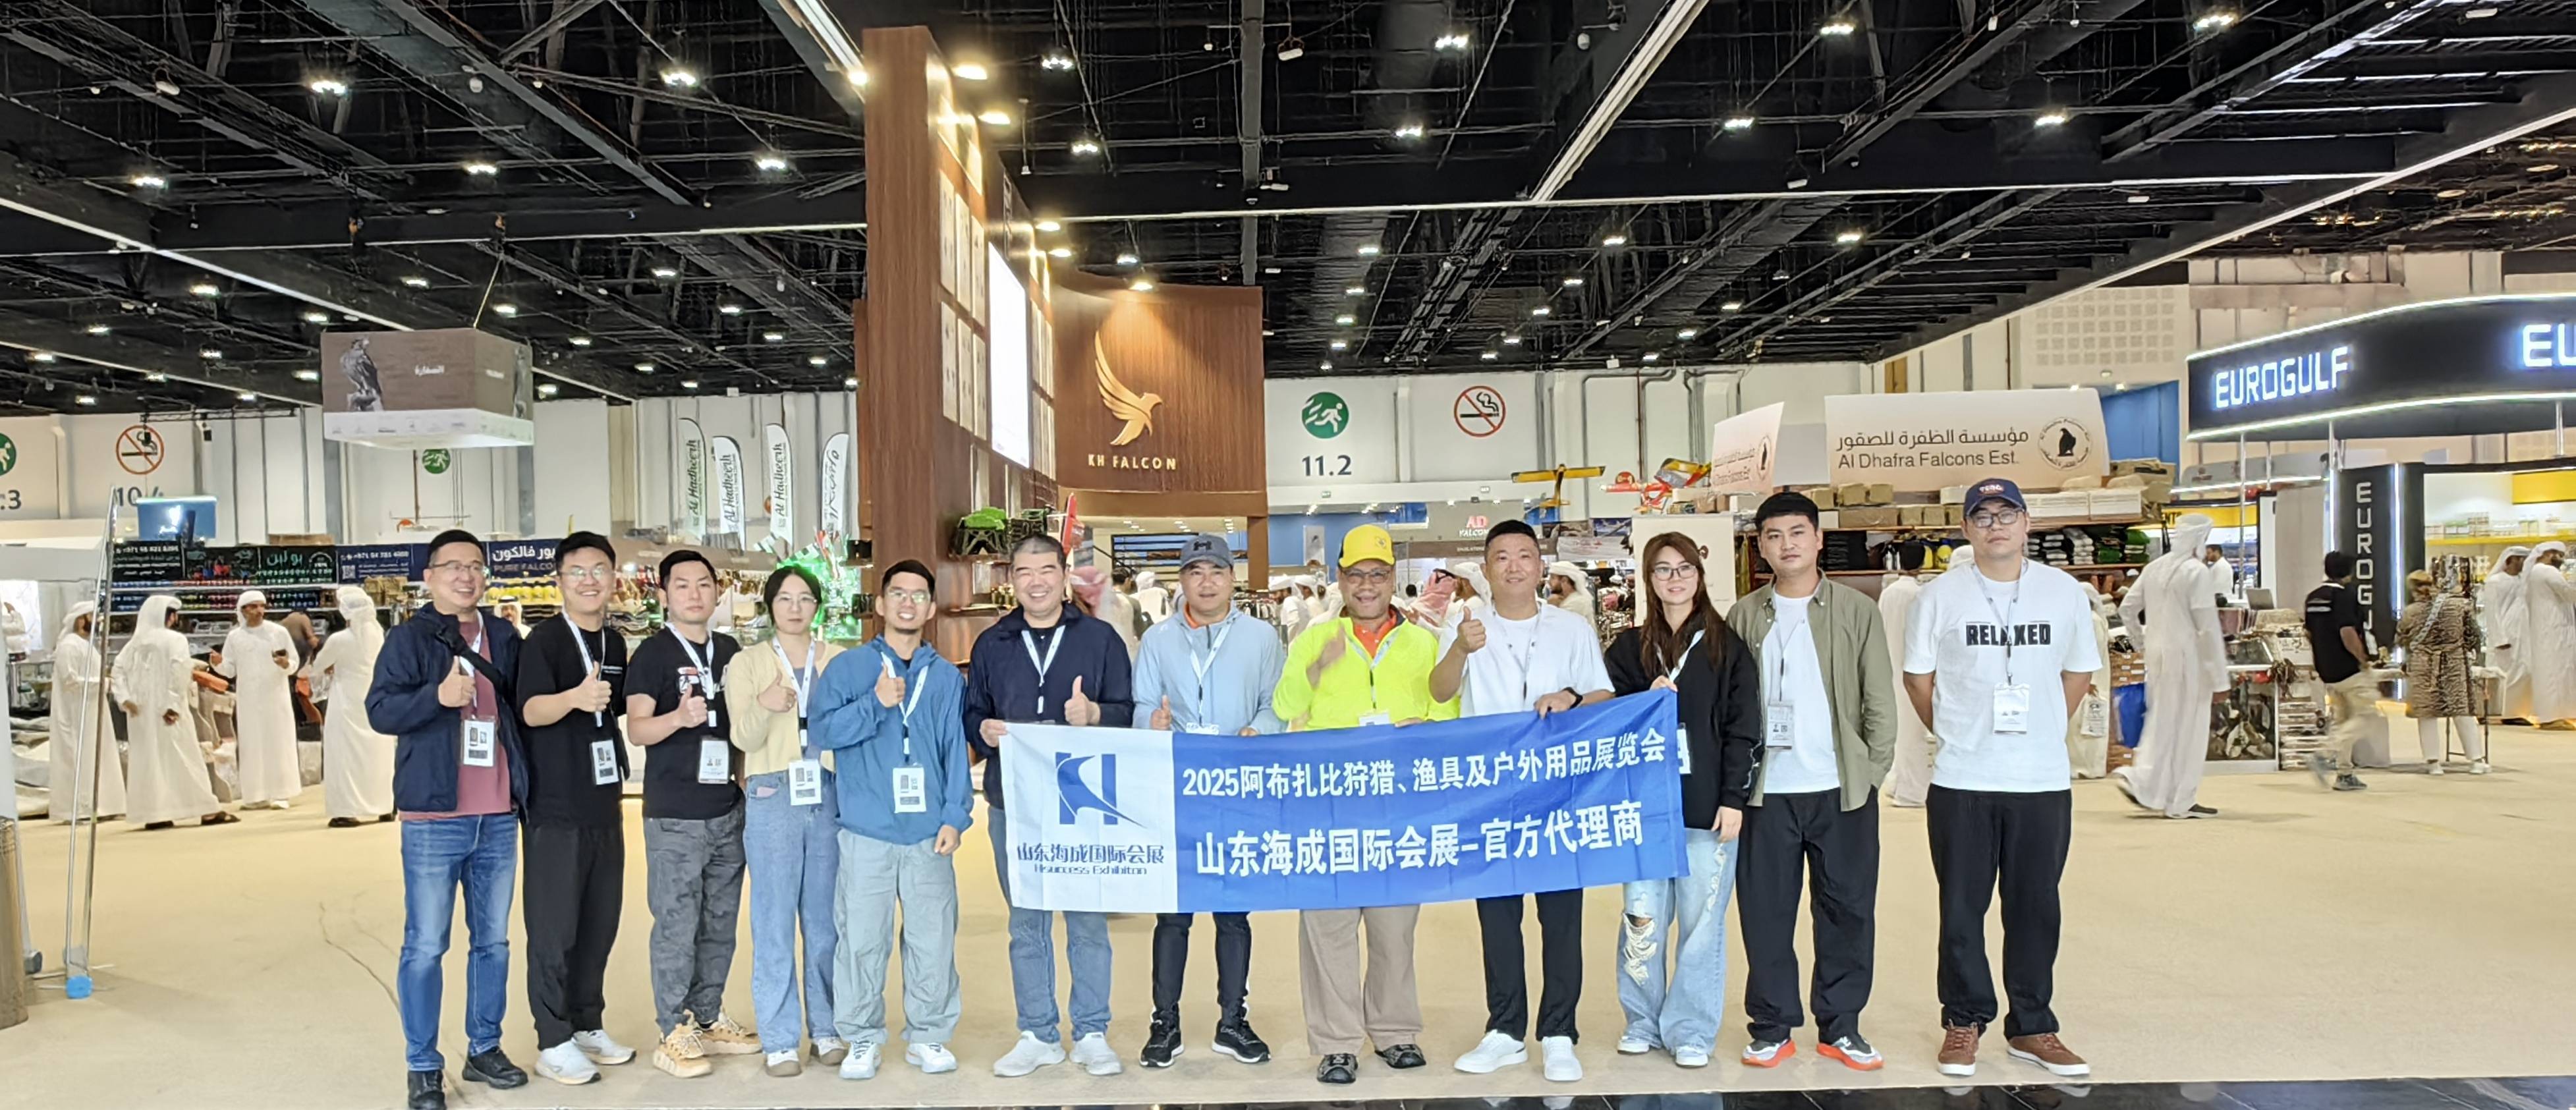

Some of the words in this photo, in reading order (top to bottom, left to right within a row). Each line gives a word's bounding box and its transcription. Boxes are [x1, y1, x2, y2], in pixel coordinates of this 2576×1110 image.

[2215, 346, 2348, 408] EUROGULF
[1835, 431, 1894, 452] للصقور
[1899, 428, 1955, 449] الظفرة
[1959, 426, 2029, 447] مؤسسة
[1088, 453, 1105, 467] KH
[1112, 455, 1177, 470] FALCON
[1301, 455, 1353, 477] 11.2
[1837, 453, 1855, 470] Al
[1859, 452, 1915, 468] Dhafra
[1919, 451, 1985, 467] Falcons
[1965, 623, 2051, 647] RELAXED
[1182, 727, 1666, 799] 2025阿布扎比狩猎、渔具及户外用品展览会
[1017, 842, 1164, 864] 山东海成国际会展
